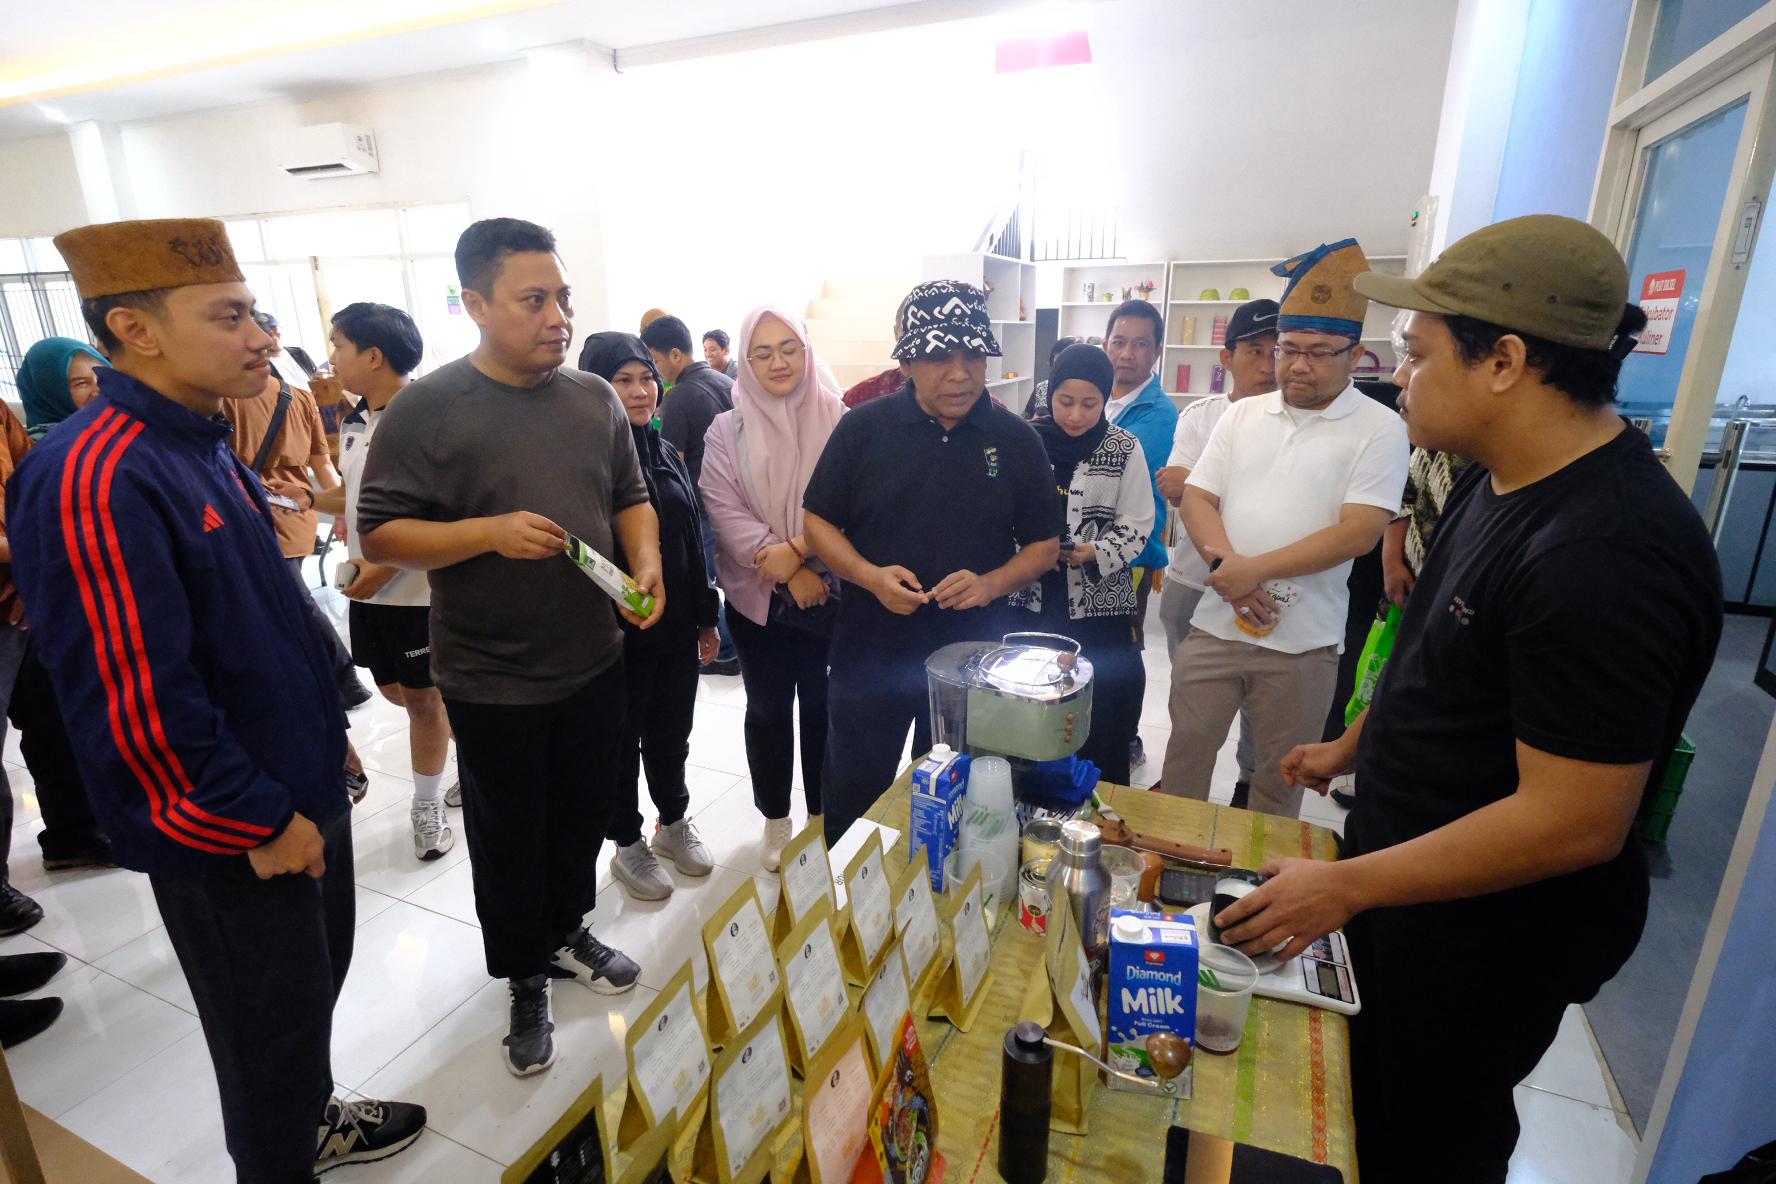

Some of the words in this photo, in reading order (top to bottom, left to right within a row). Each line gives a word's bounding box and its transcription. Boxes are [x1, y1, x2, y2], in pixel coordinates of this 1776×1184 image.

[1639, 330, 1663, 345] uliner
[404, 646, 430, 659] TERRE
[1126, 965, 1182, 986] Diamond
[1121, 987, 1184, 1015] Milk
